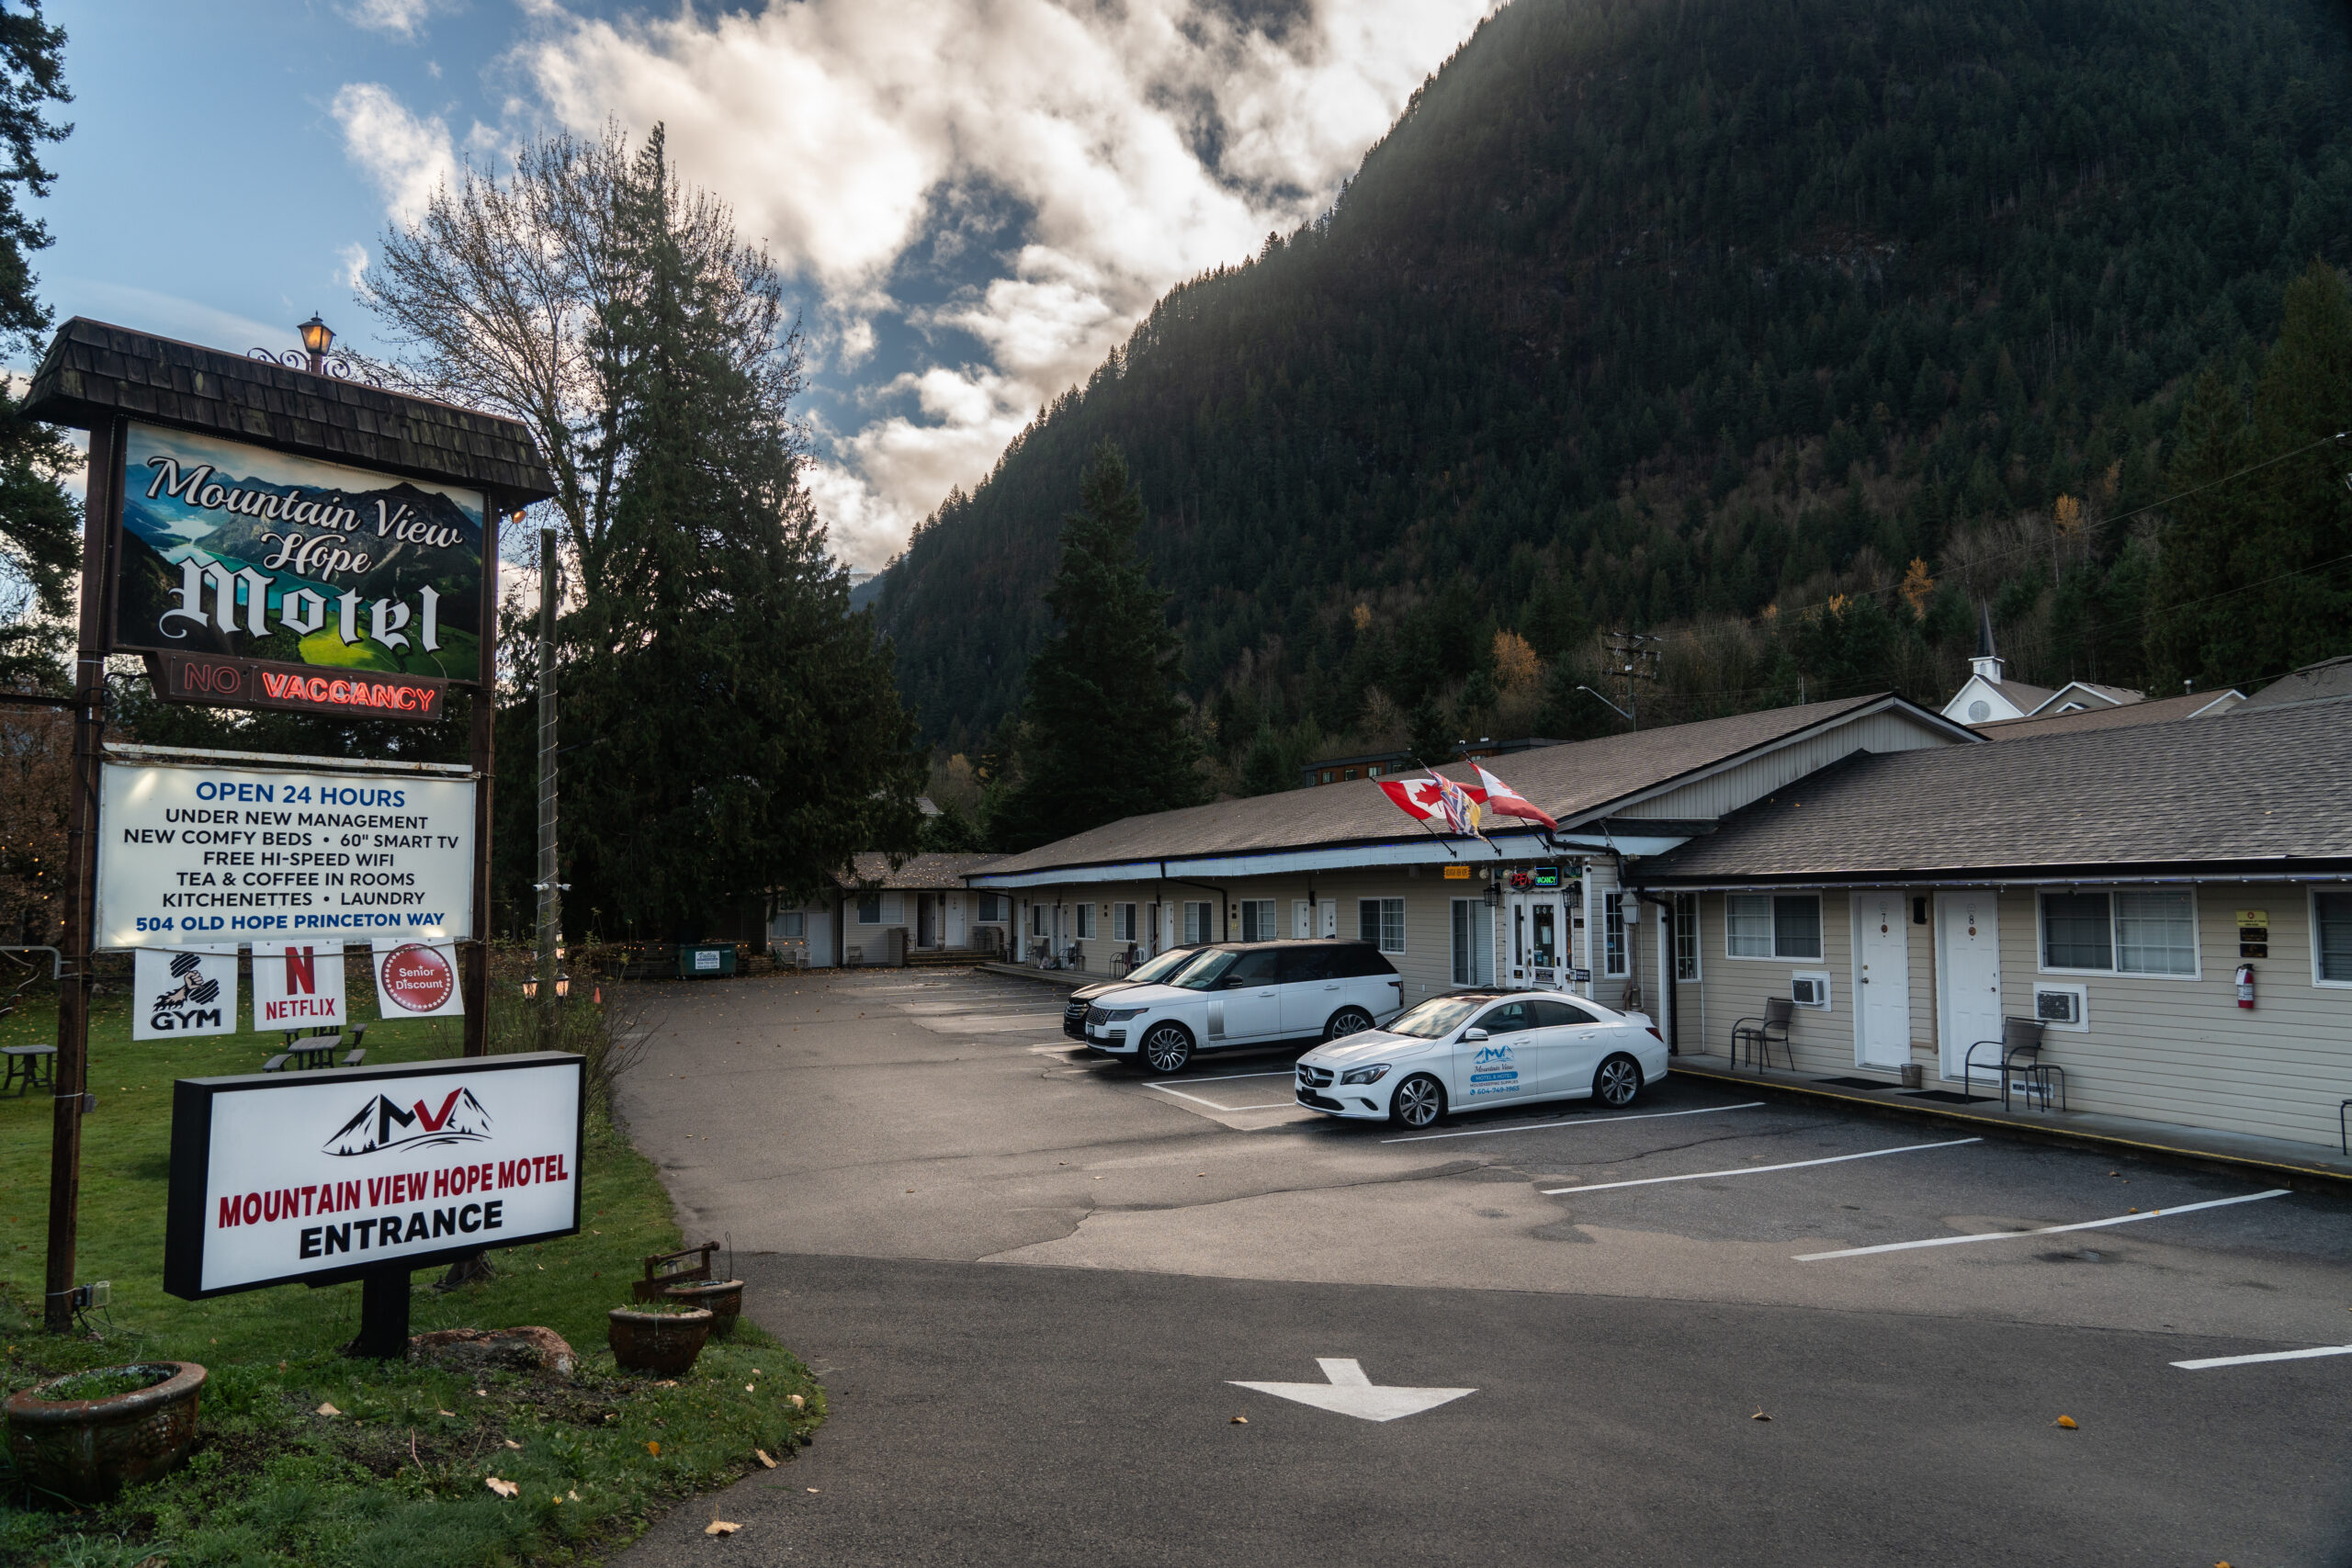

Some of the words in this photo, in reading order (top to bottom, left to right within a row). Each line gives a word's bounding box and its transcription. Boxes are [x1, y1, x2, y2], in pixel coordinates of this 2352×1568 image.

[146, 457, 361, 533] Mountain
[375, 499, 462, 548] View
[261, 532, 371, 581] Hope
[159, 558, 441, 654] Motel
[185, 662, 241, 694] NO
[196, 781, 275, 804] OPEN
[283, 784, 311, 805] 24
[321, 787, 405, 808] HOURS
[165, 808, 239, 825] UNDER
[244, 811, 292, 827] NEW
[298, 812, 428, 829] MANAGEMENT
[123, 829, 176, 845] NEW
[182, 829, 256, 846] COMFY
[263, 831, 312, 847] BEDS
[340, 833, 369, 848] 60"
[374, 834, 433, 849] SMART
[437, 836, 458, 850] TV
[203, 851, 254, 866] FREE
[261, 852, 350, 867] HI-SPEED
[356, 852, 394, 867] WIFI
[176, 871, 216, 886] TEA
[222, 871, 237, 886] &
[242, 871, 320, 886] COFFEE
[324, 872, 345, 886] IN
[350, 872, 415, 886] ROOMS
[162, 892, 312, 908] KITCHENETTES
[341, 891, 425, 907] LAUNDRY
[135, 916, 175, 932] 504
[181, 916, 225, 931] OLD
[232, 915, 288, 931] HOPE
[294, 913, 401, 929] PRINCETON
[406, 912, 445, 926] WAY
[1881, 913, 1886, 923] 7
[1969, 915, 1974, 925] 8
[285, 946, 315, 996] N
[399, 965, 435, 978] Senior
[395, 977, 443, 991] Discount
[151, 1009, 221, 1032] GYM
[266, 998, 336, 1021] NETFLIX
[219, 1179, 361, 1229] MOUNTAIN
[367, 1171, 429, 1207] VIEW
[433, 1163, 493, 1199] HOPE
[497, 1153, 568, 1190] MOTEL
[300, 1200, 503, 1259] ENTRANCE
